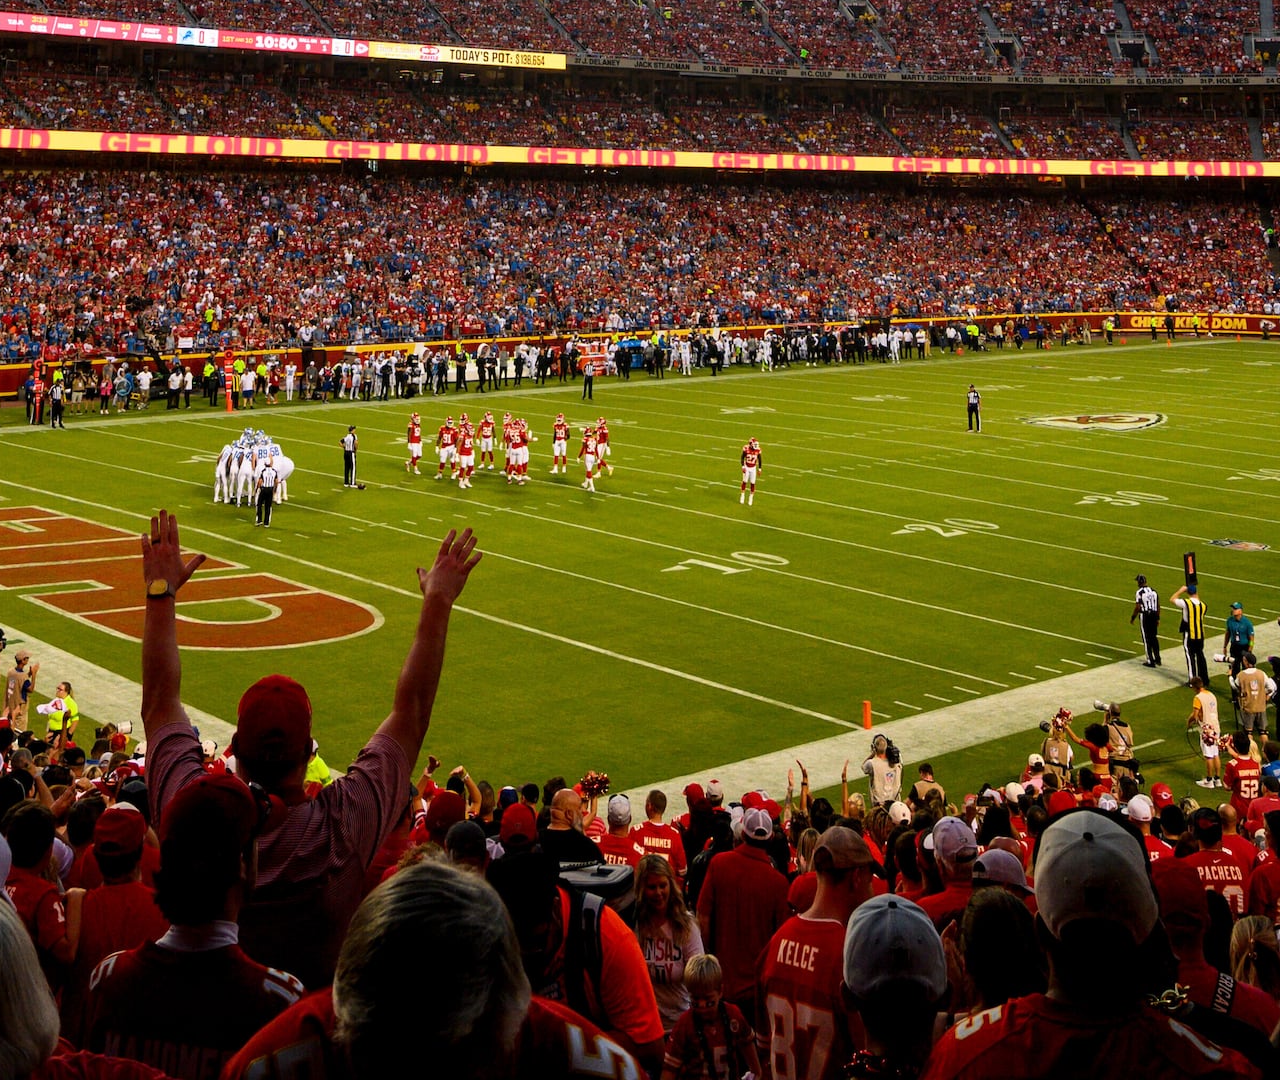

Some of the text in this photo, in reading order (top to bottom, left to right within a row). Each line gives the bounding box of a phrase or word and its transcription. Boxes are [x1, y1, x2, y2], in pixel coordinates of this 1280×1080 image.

[255, 35, 298, 51] 10:50
[450, 48, 513, 64] TODAY'S POT:
[589, 58, 620, 67] DELANEY
[634, 60, 690, 70] JACK STEADMAN
[858, 73, 887, 81] LOWERY
[927, 75, 993, 83] SCHOTTENHEIMER
[1023, 76, 1044, 84] ROSS
[1078, 77, 1111, 85] SHIELDS
[1145, 78, 1184, 86] BARBARO
[1216, 77, 1250, 85] HOLMES
[101, 133, 283, 157] GET LOUD
[326, 142, 488, 163] GET LOUD
[527, 148, 676, 167] GET LOUD
[713, 153, 855, 171] GET LOUD
[893, 158, 1048, 174] GET LOUD
[1091, 161, 1264, 177] GET LOUD
[442, 433, 453, 445] 91
[258, 449, 268, 459] 89
[745, 453, 758, 465] 27
[1090, 490, 1170, 507] 30
[904, 518, 1000, 538] 20
[678, 551, 790, 575] 10
[1240, 781, 1260, 800] 52
[1198, 865, 1243, 881] PACHECO
[776, 938, 820, 972] KELCE
[767, 993, 836, 1080] 87
